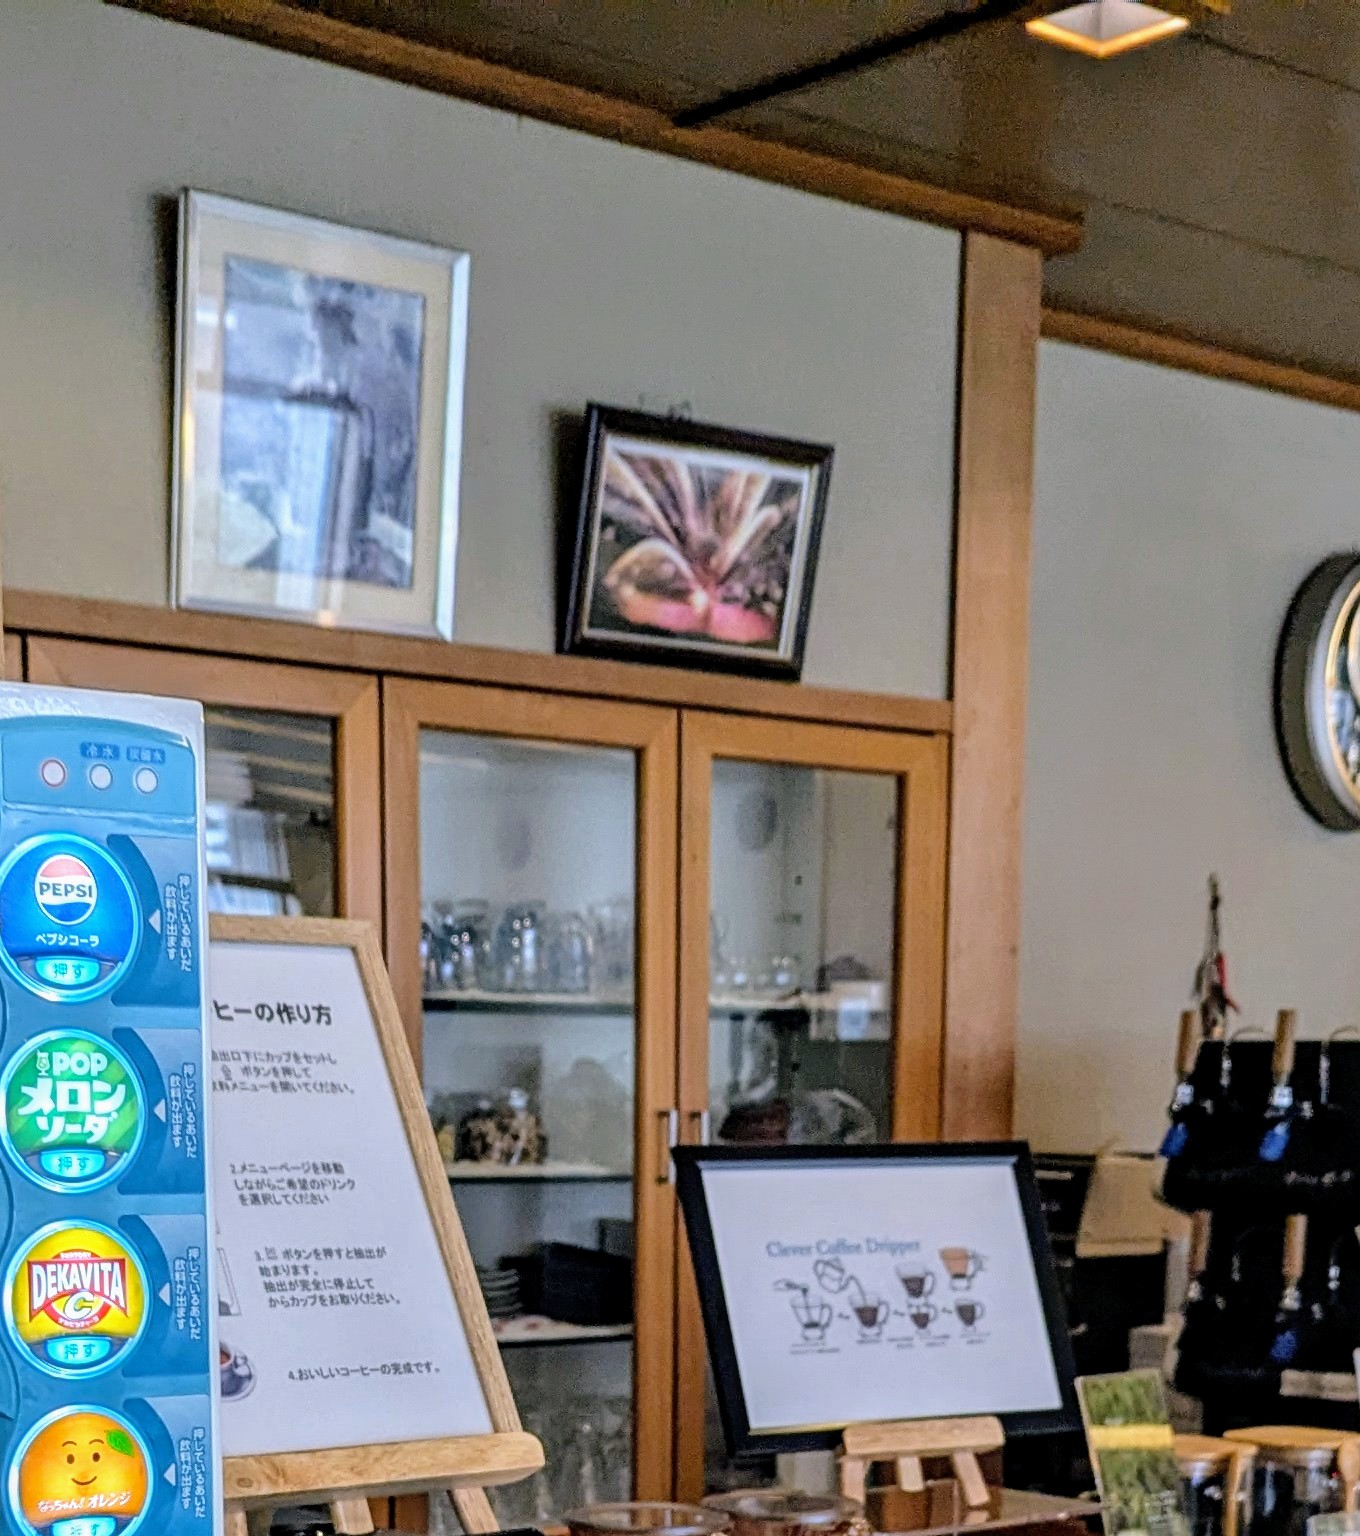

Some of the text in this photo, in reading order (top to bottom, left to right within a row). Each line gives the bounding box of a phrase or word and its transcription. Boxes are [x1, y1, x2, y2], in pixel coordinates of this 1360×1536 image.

[40, 882, 93, 899] PEPSI
[35, 932, 99, 948] ペプシコーラ
[52, 961, 85, 980] 押す
[213, 1000, 332, 1026] ヒーの作り方
[52, 1051, 107, 1077] POP
[18, 1078, 126, 1115] メロン
[36, 1111, 118, 1144] ソーダ
[58, 1156, 89, 1171] 押す
[816, 1238, 861, 1254] Coffee
[32, 1262, 126, 1310] DEKAVITA
[63, 1290, 94, 1320] C
[65, 1344, 95, 1359] 押す
